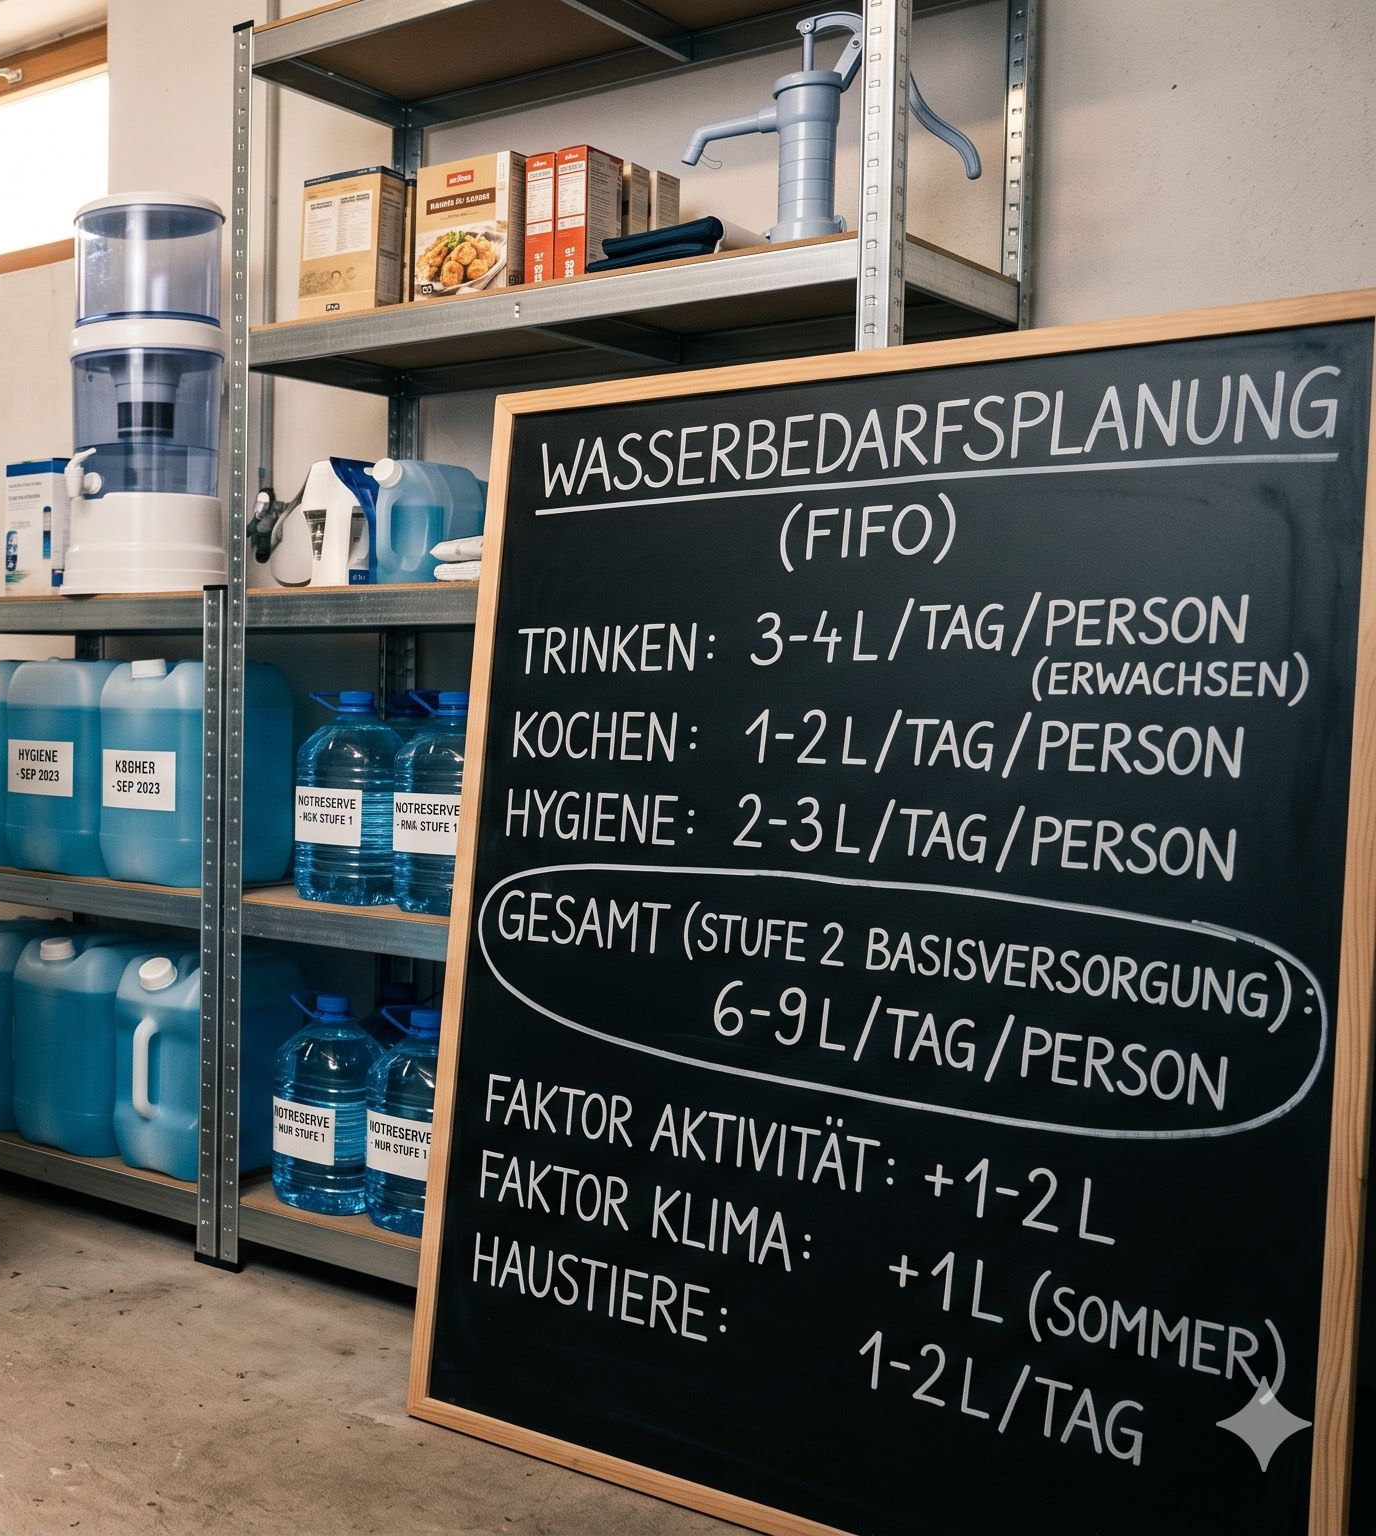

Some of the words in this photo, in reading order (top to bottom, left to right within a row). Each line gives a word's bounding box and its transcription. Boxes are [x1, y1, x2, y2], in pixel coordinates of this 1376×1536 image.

[542, 366, 1341, 498] WASSERBEDARFSPLANUNG
[780, 493, 956, 572] (FIFO)
[519, 623, 715, 674] TRINKEN:
[1032, 652, 1308, 706] (ERWACHSEN)
[513, 711, 697, 762] KOCHEN:
[18, 749, 58, 762] HYGIENE
[39, 769, 60, 782] 2023
[137, 782, 160, 795] 2023
[320, 814, 346, 825] STUFE
[349, 816, 353, 825] 1
[396, 802, 461, 816] NOTRESERVE
[420, 821, 450, 832] STUFE
[453, 823, 457, 833] 1
[506, 789, 694, 845] HYGIENE:
[499, 890, 671, 953] GESAMT
[684, 901, 807, 961] (STUFE
[821, 922, 844, 966] 2
[866, 928, 1314, 1032] BASISVERSORGUNG):
[274, 1105, 330, 1128] NOTRESERVE
[295, 1128, 319, 1142] STUFE
[321, 1133, 325, 1142] 1
[369, 1120, 432, 1144] NOTRESERVE
[486, 1074, 632, 1147] FAKTOR
[650, 1104, 894, 1192] AKTIVITÄT:
[393, 1144, 420, 1158] STUFE
[423, 1150, 427, 1159] 1
[473, 1232, 727, 1341] HAUSTIERE:
[480, 1150, 628, 1231] FAKTOR
[652, 1186, 811, 1271] KLIMA:
[1029, 1270, 1285, 1403] (SOMMER)
